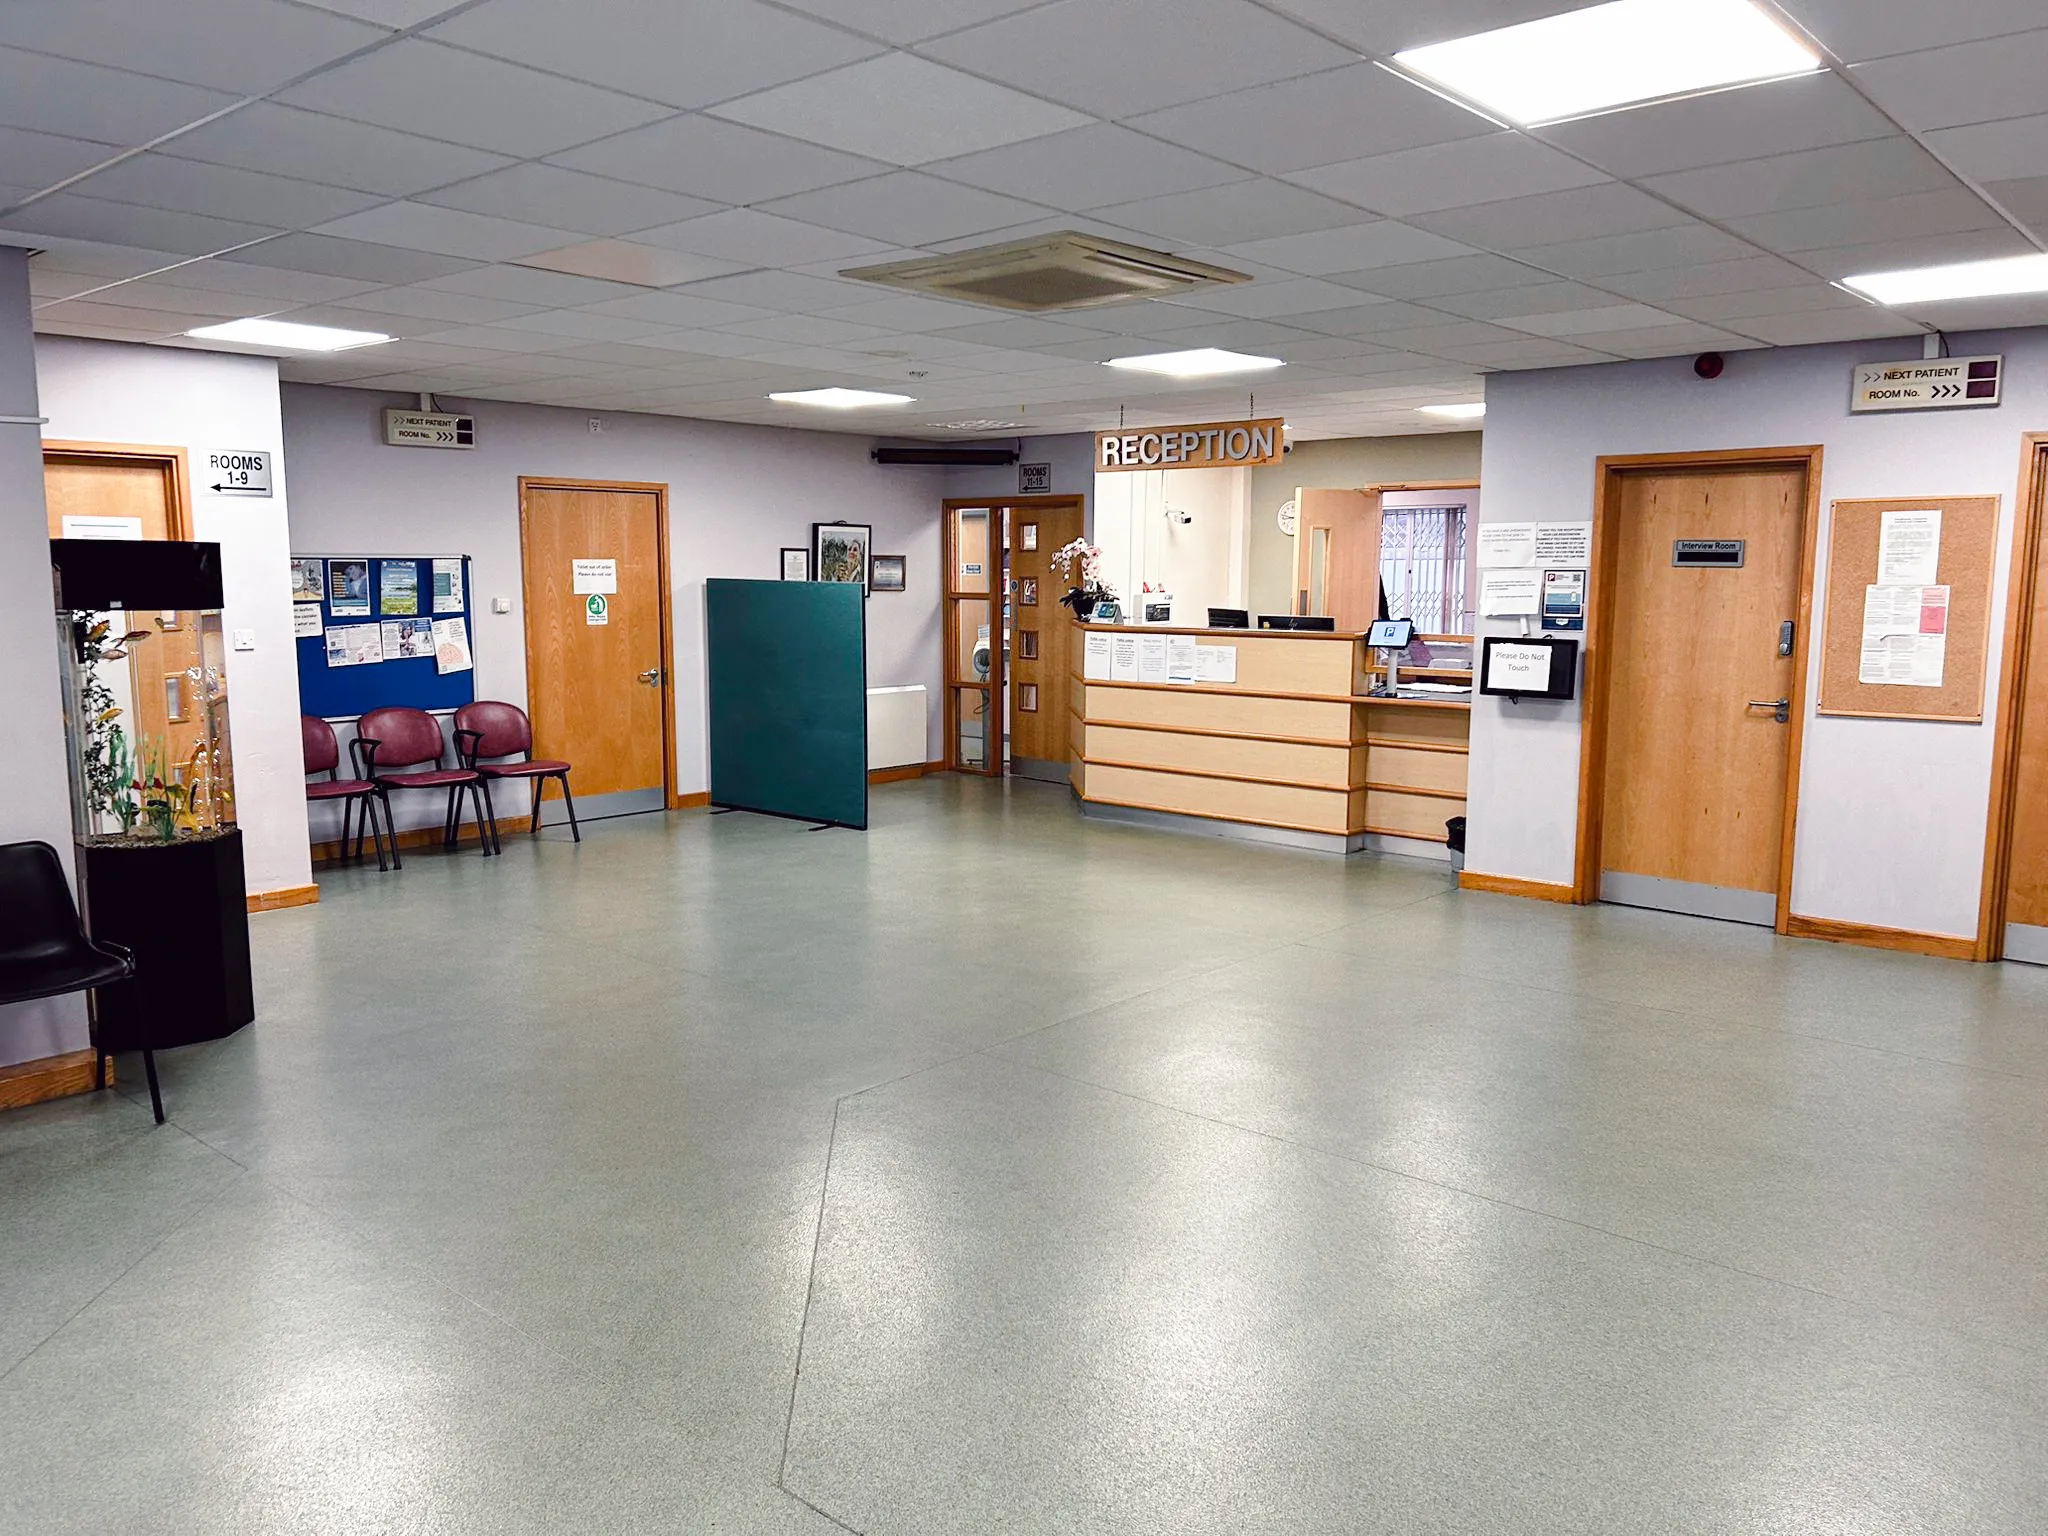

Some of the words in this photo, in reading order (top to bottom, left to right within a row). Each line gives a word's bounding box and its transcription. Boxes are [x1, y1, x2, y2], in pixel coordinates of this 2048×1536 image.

[1883, 371, 1913, 381] NEXT
[1915, 367, 1960, 379] PATIENT
[1869, 389, 1901, 399] ROOM
[1903, 389, 1920, 398] No.
[425, 419, 452, 427] PATIENT
[398, 430, 420, 438] ROOM
[1101, 426, 1274, 466] RECEPTION
[210, 454, 263, 471] ROOMS
[1023, 466, 1047, 477] ROOMS
[227, 471, 249, 485] 1-9
[1027, 477, 1043, 486] 11-15
[1681, 542, 1713, 550] Interview
[1714, 542, 1736, 550] Room
[1495, 651, 1518, 660] Please
[1519, 652, 1530, 661] Do
[1531, 653, 1545, 661] Not
[1508, 663, 1530, 672] Touch
